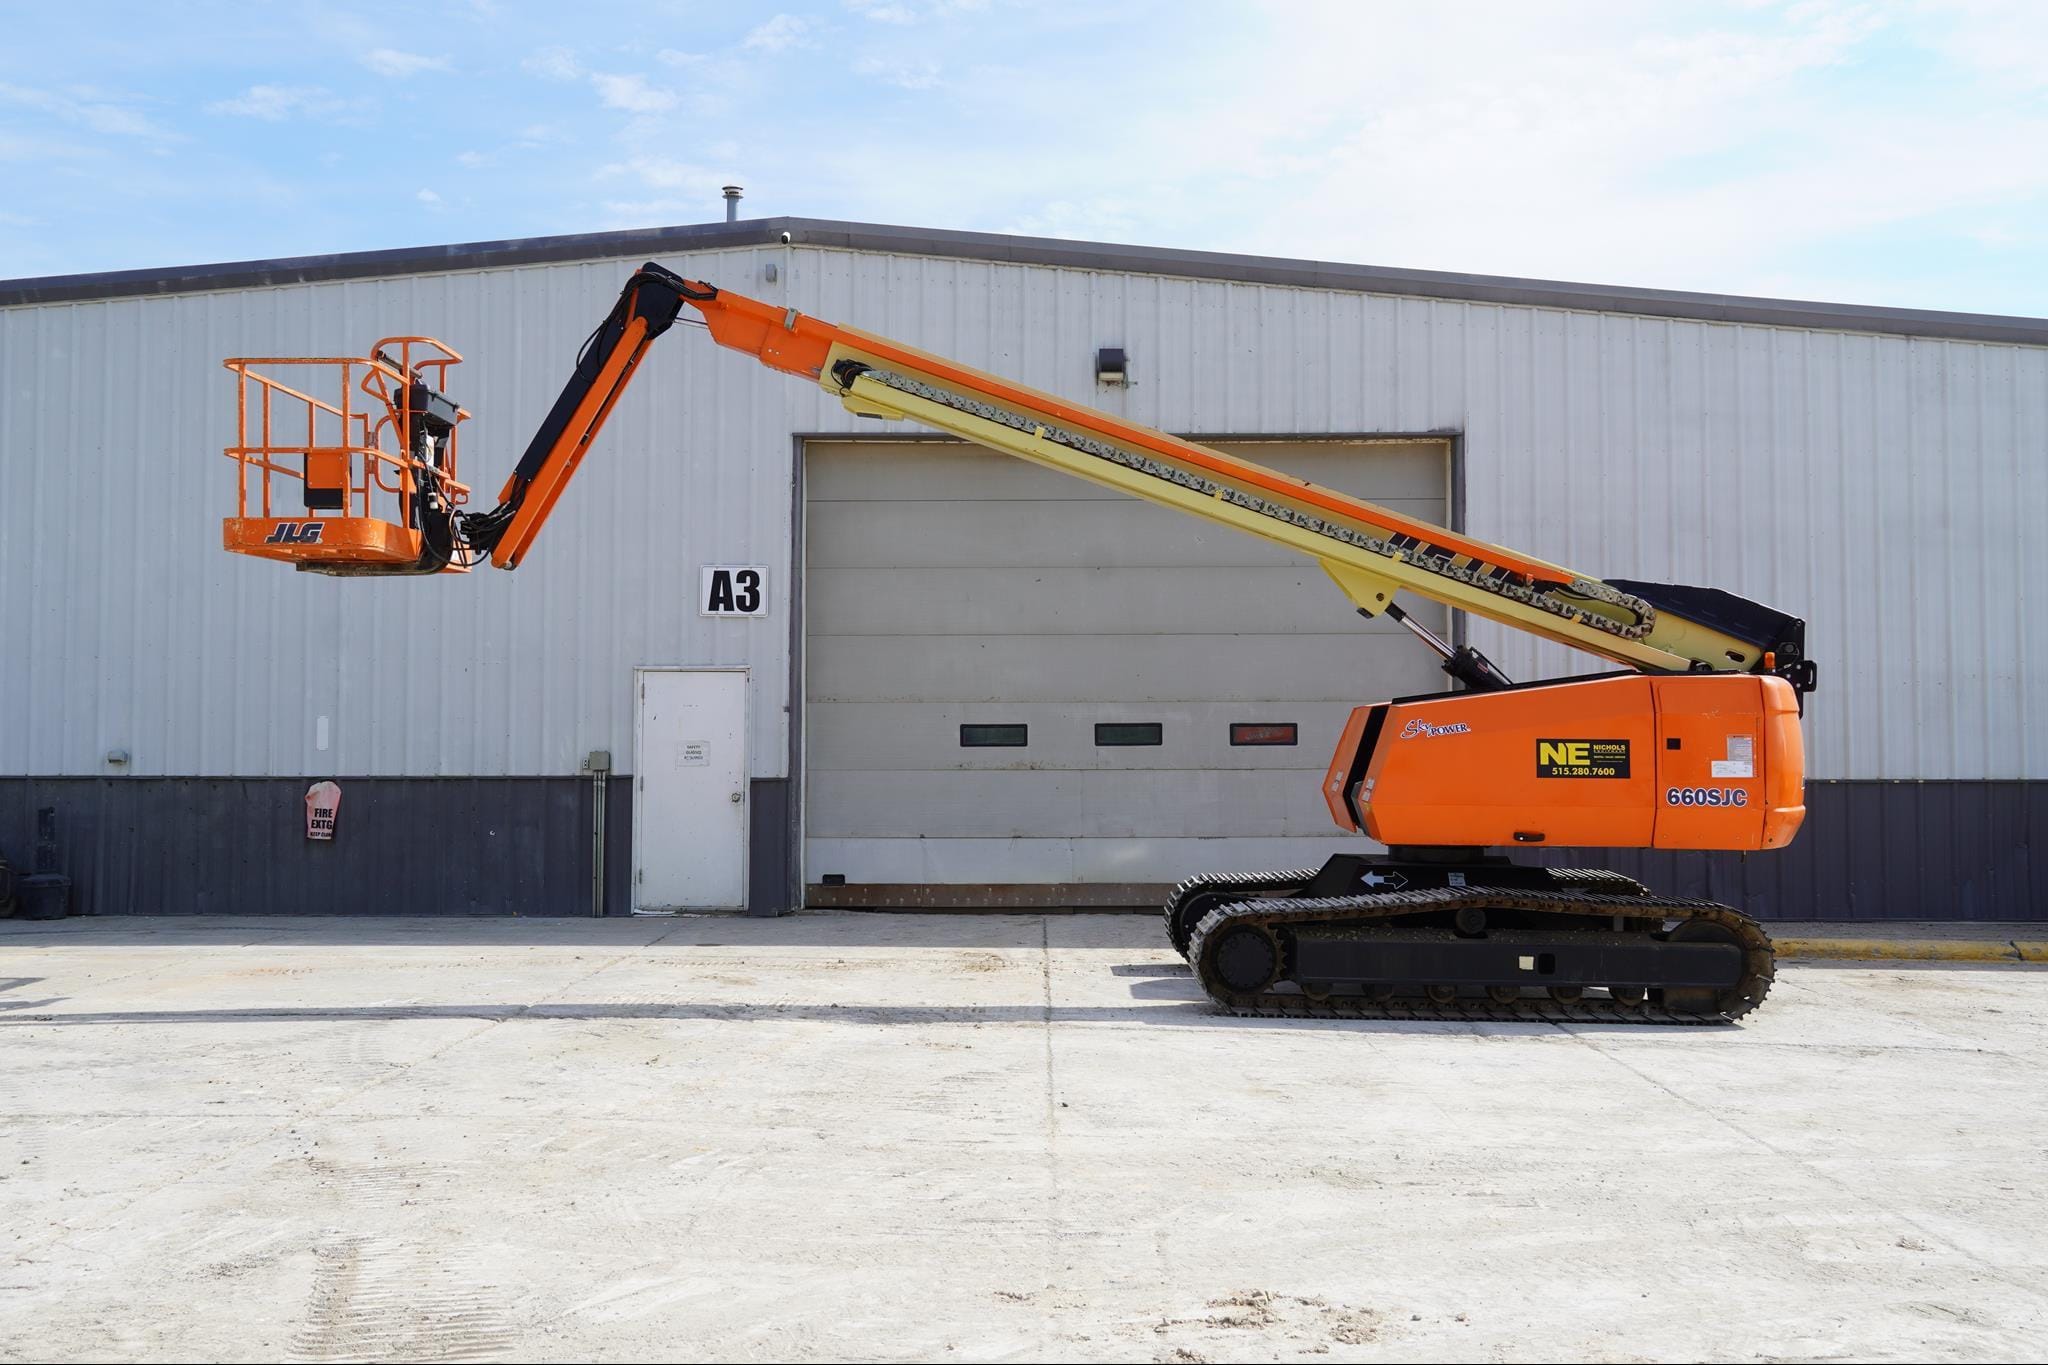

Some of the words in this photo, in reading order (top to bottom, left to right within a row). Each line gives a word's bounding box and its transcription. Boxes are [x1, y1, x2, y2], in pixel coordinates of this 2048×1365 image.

[264, 521, 325, 544] JLG
[708, 569, 760, 612] A3
[1430, 722, 1468, 736] POWER
[1540, 742, 1591, 765] NE
[1551, 767, 1616, 776] 515.280.7600
[1666, 787, 1748, 807] 660SJC
[314, 808, 333, 818] FIRE
